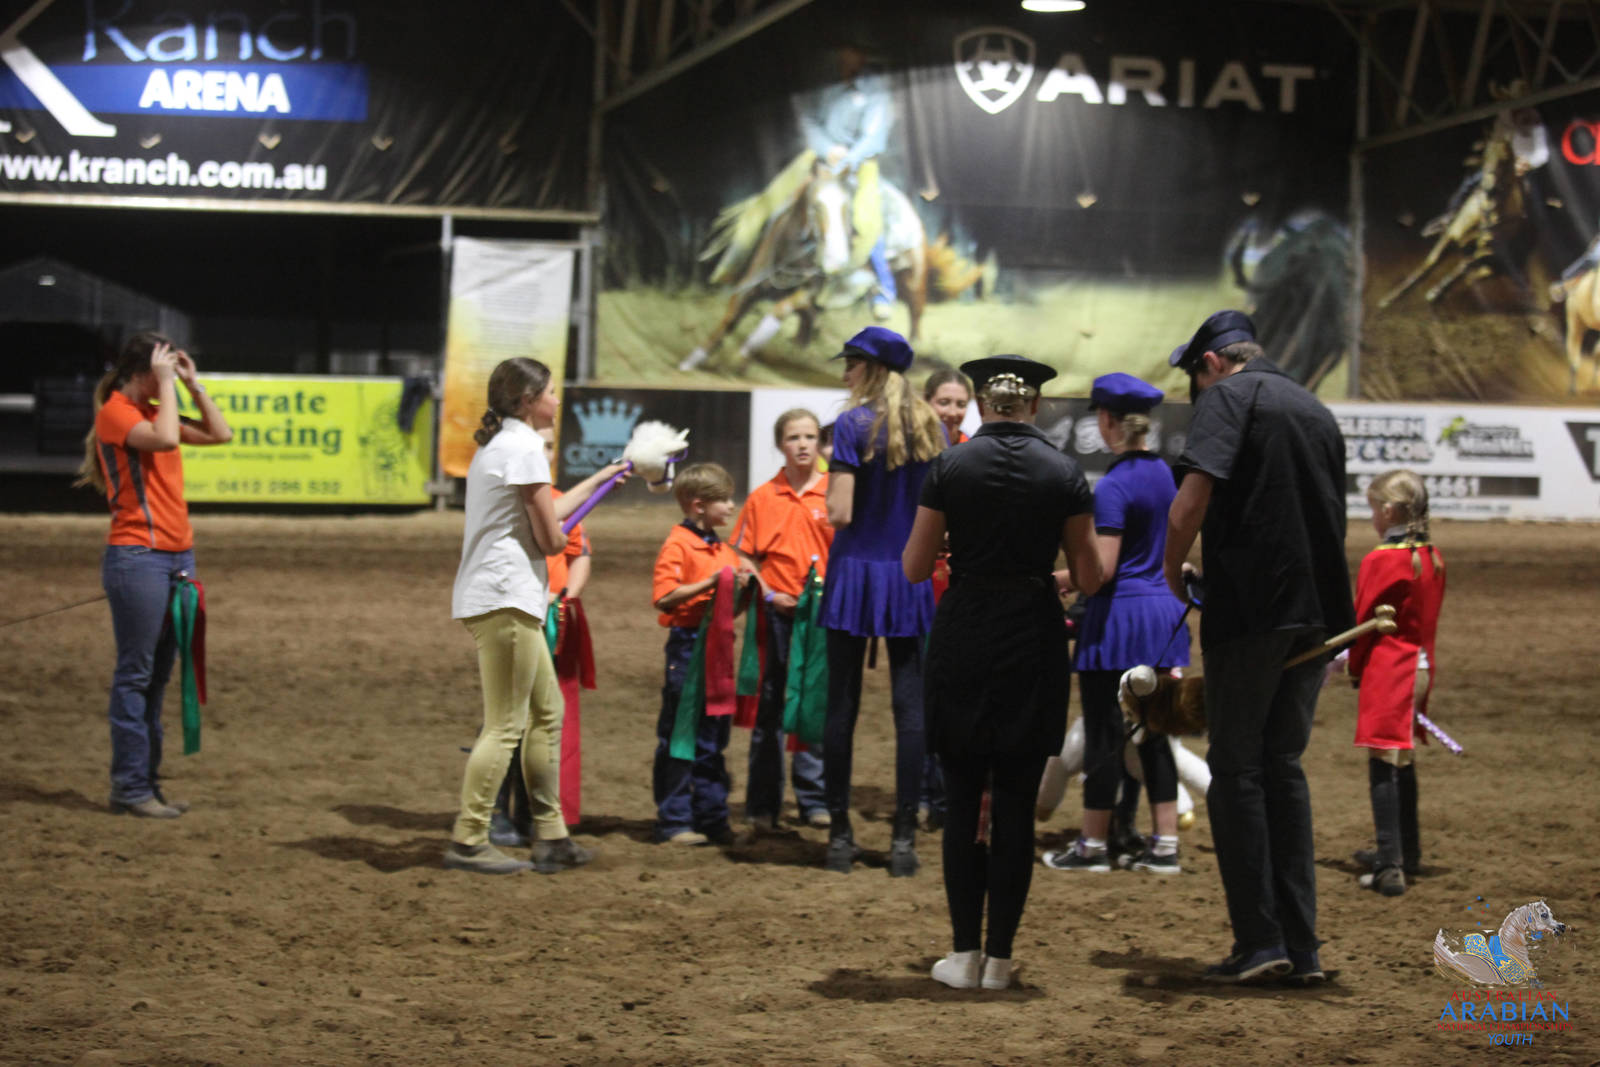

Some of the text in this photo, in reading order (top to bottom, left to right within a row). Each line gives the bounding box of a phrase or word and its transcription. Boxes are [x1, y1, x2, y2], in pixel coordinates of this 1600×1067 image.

[82, 0, 357, 62] Ranch
[138, 69, 291, 113] ARENA
[1036, 53, 1315, 112] ARIAT
[0, 149, 327, 190] ww.kranch.com.au
[175, 385, 328, 414] curate
